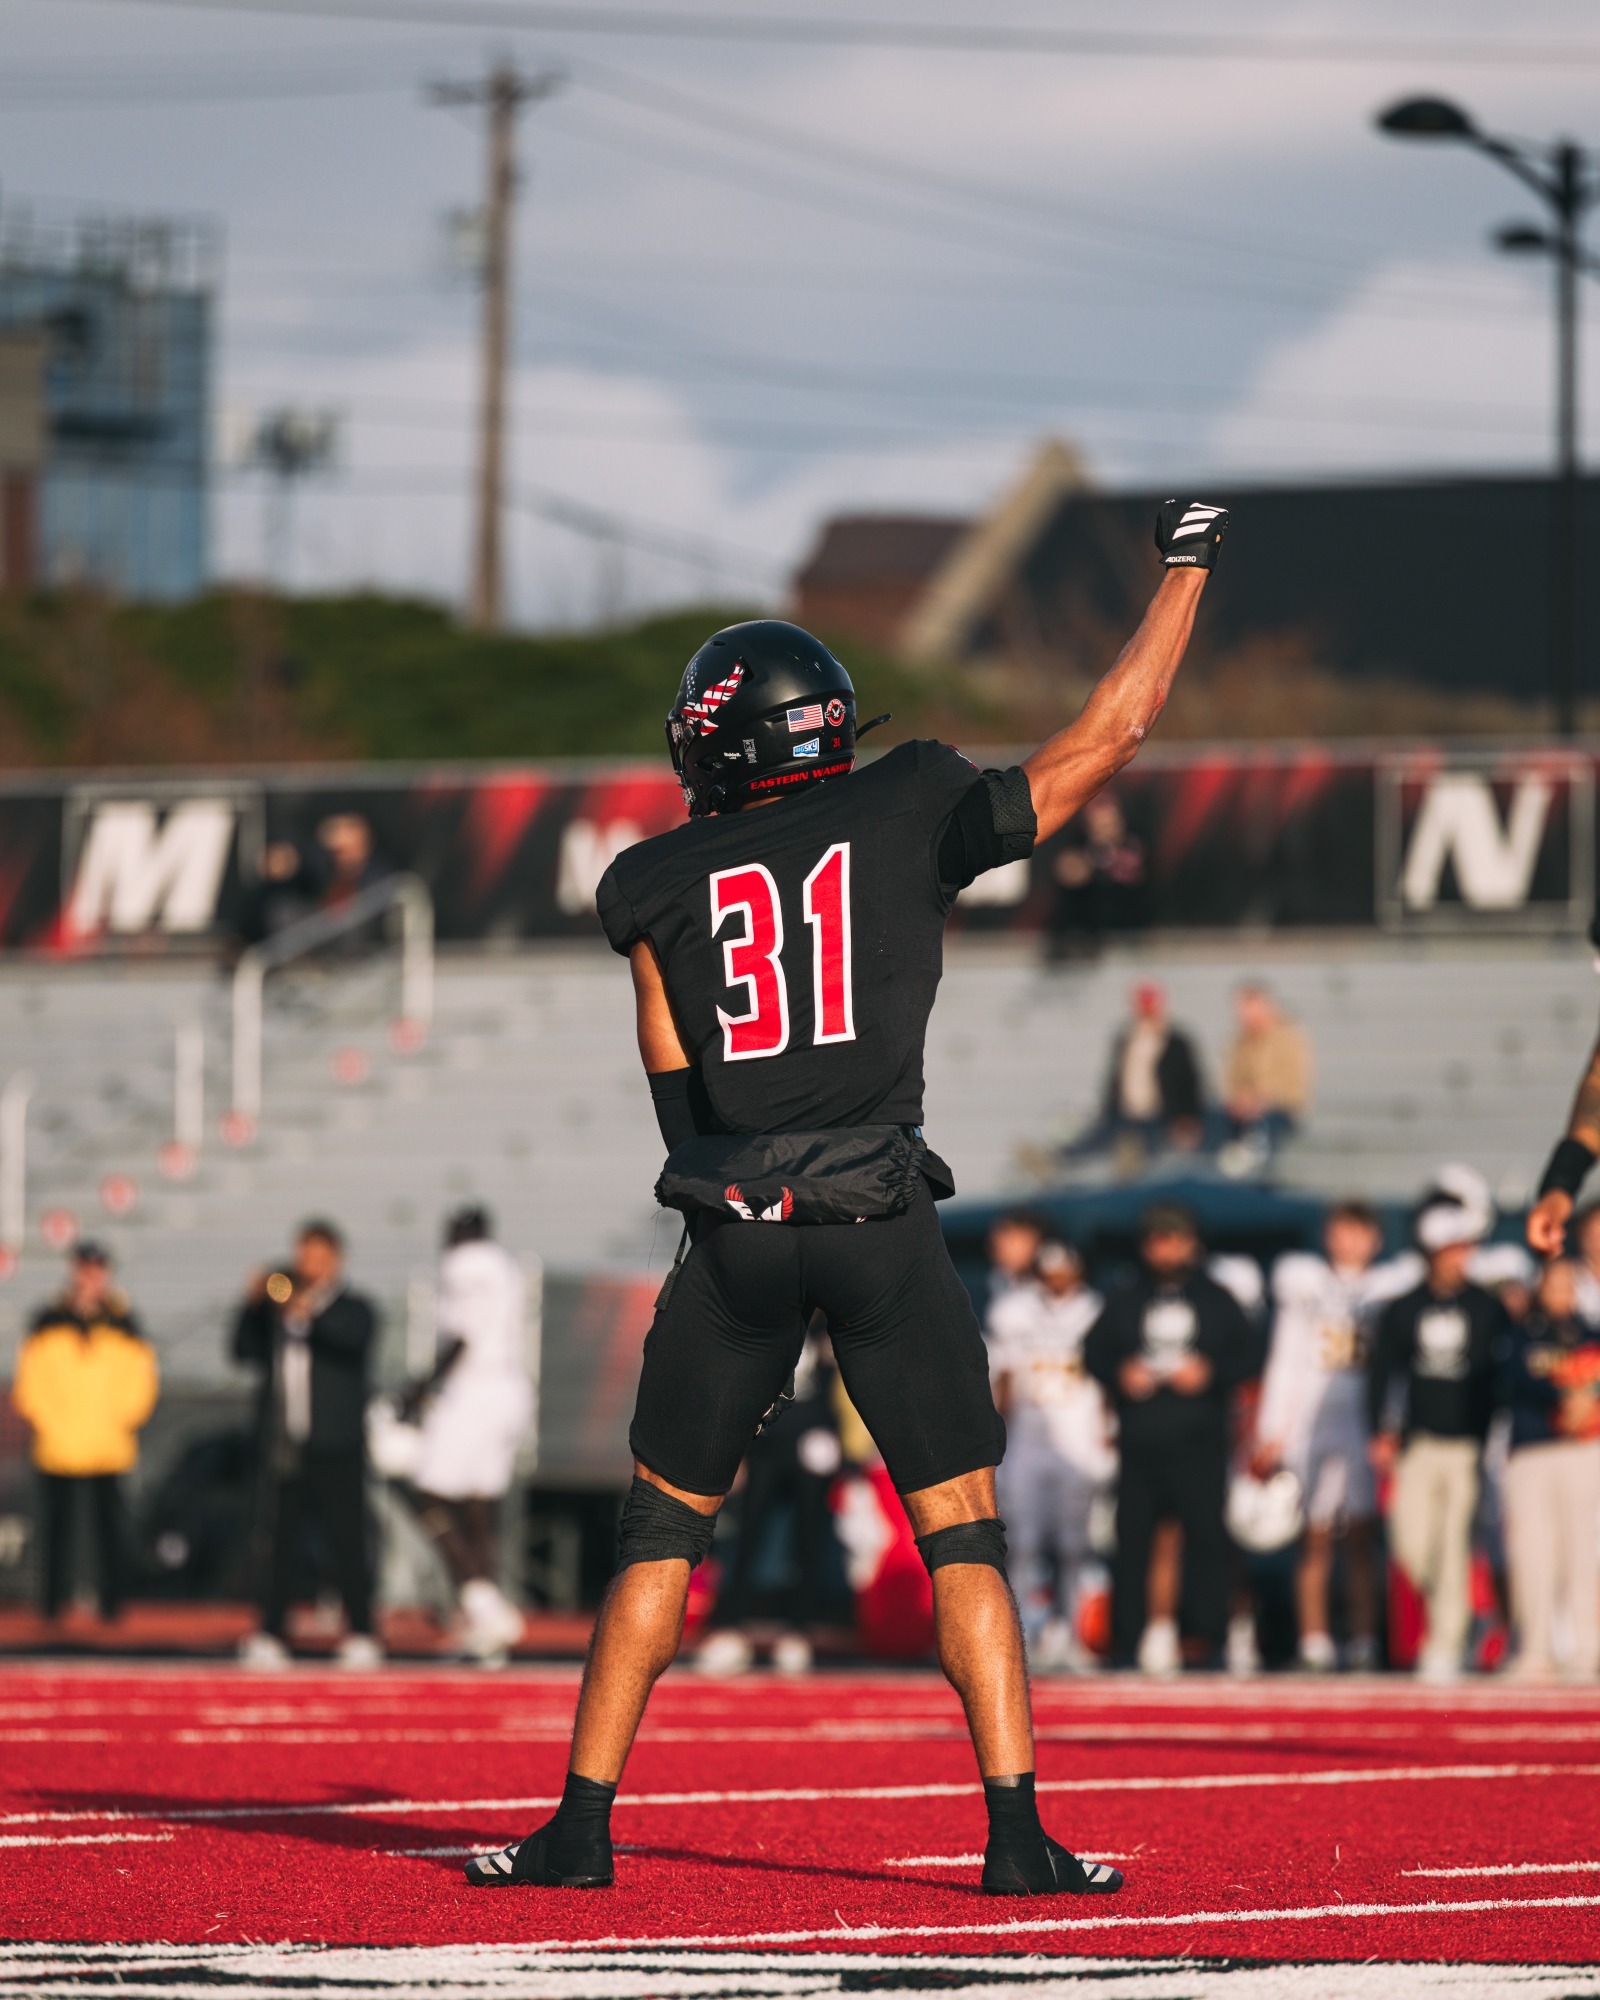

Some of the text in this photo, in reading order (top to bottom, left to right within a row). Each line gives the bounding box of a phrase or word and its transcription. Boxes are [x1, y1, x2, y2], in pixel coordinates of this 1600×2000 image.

[750, 771, 809, 790] EASTERN
[1402, 769, 1554, 912] N
[72, 799, 234, 935] M
[709, 842, 857, 1062] 31
